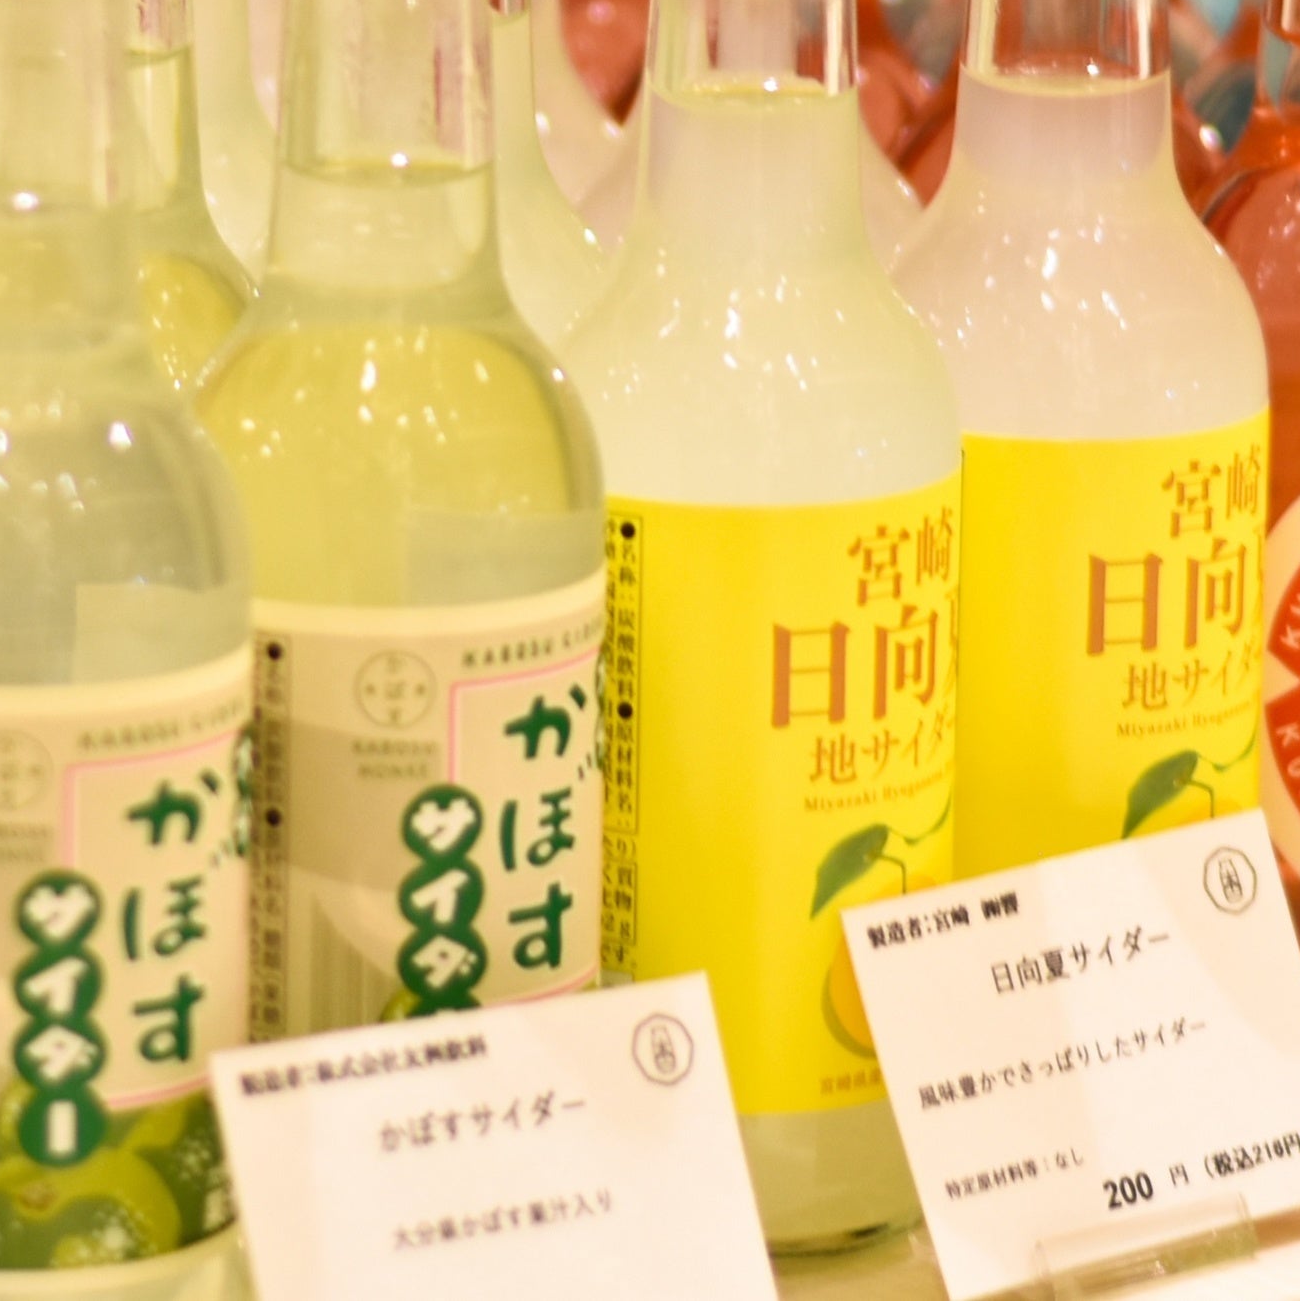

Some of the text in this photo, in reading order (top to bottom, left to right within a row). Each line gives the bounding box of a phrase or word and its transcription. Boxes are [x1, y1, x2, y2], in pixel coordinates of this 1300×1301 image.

[1160, 443, 1262, 540] 宮崎
[847, 506, 953, 608] 宮崎
[1121, 641, 1261, 712] 地サイダ
[809, 704, 953, 786] 地サイダ
[1116, 718, 1187, 740] Miyazaki
[503, 683, 589, 970] かぼす
[803, 789, 877, 813] Miyazaki
[126, 768, 221, 1064] かぼす
[408, 796, 479, 991] サイダ
[990, 928, 1172, 995] 日向夏サイダー
[22, 883, 99, 1157] サイダー
[916, 1015, 1208, 1111] 風味豊かでさっぱりしたサイダー
[378, 1088, 589, 1155] かぼすサイダー
[1103, 1171, 1155, 1211] 200
[1169, 1163, 1190, 1188] 円
